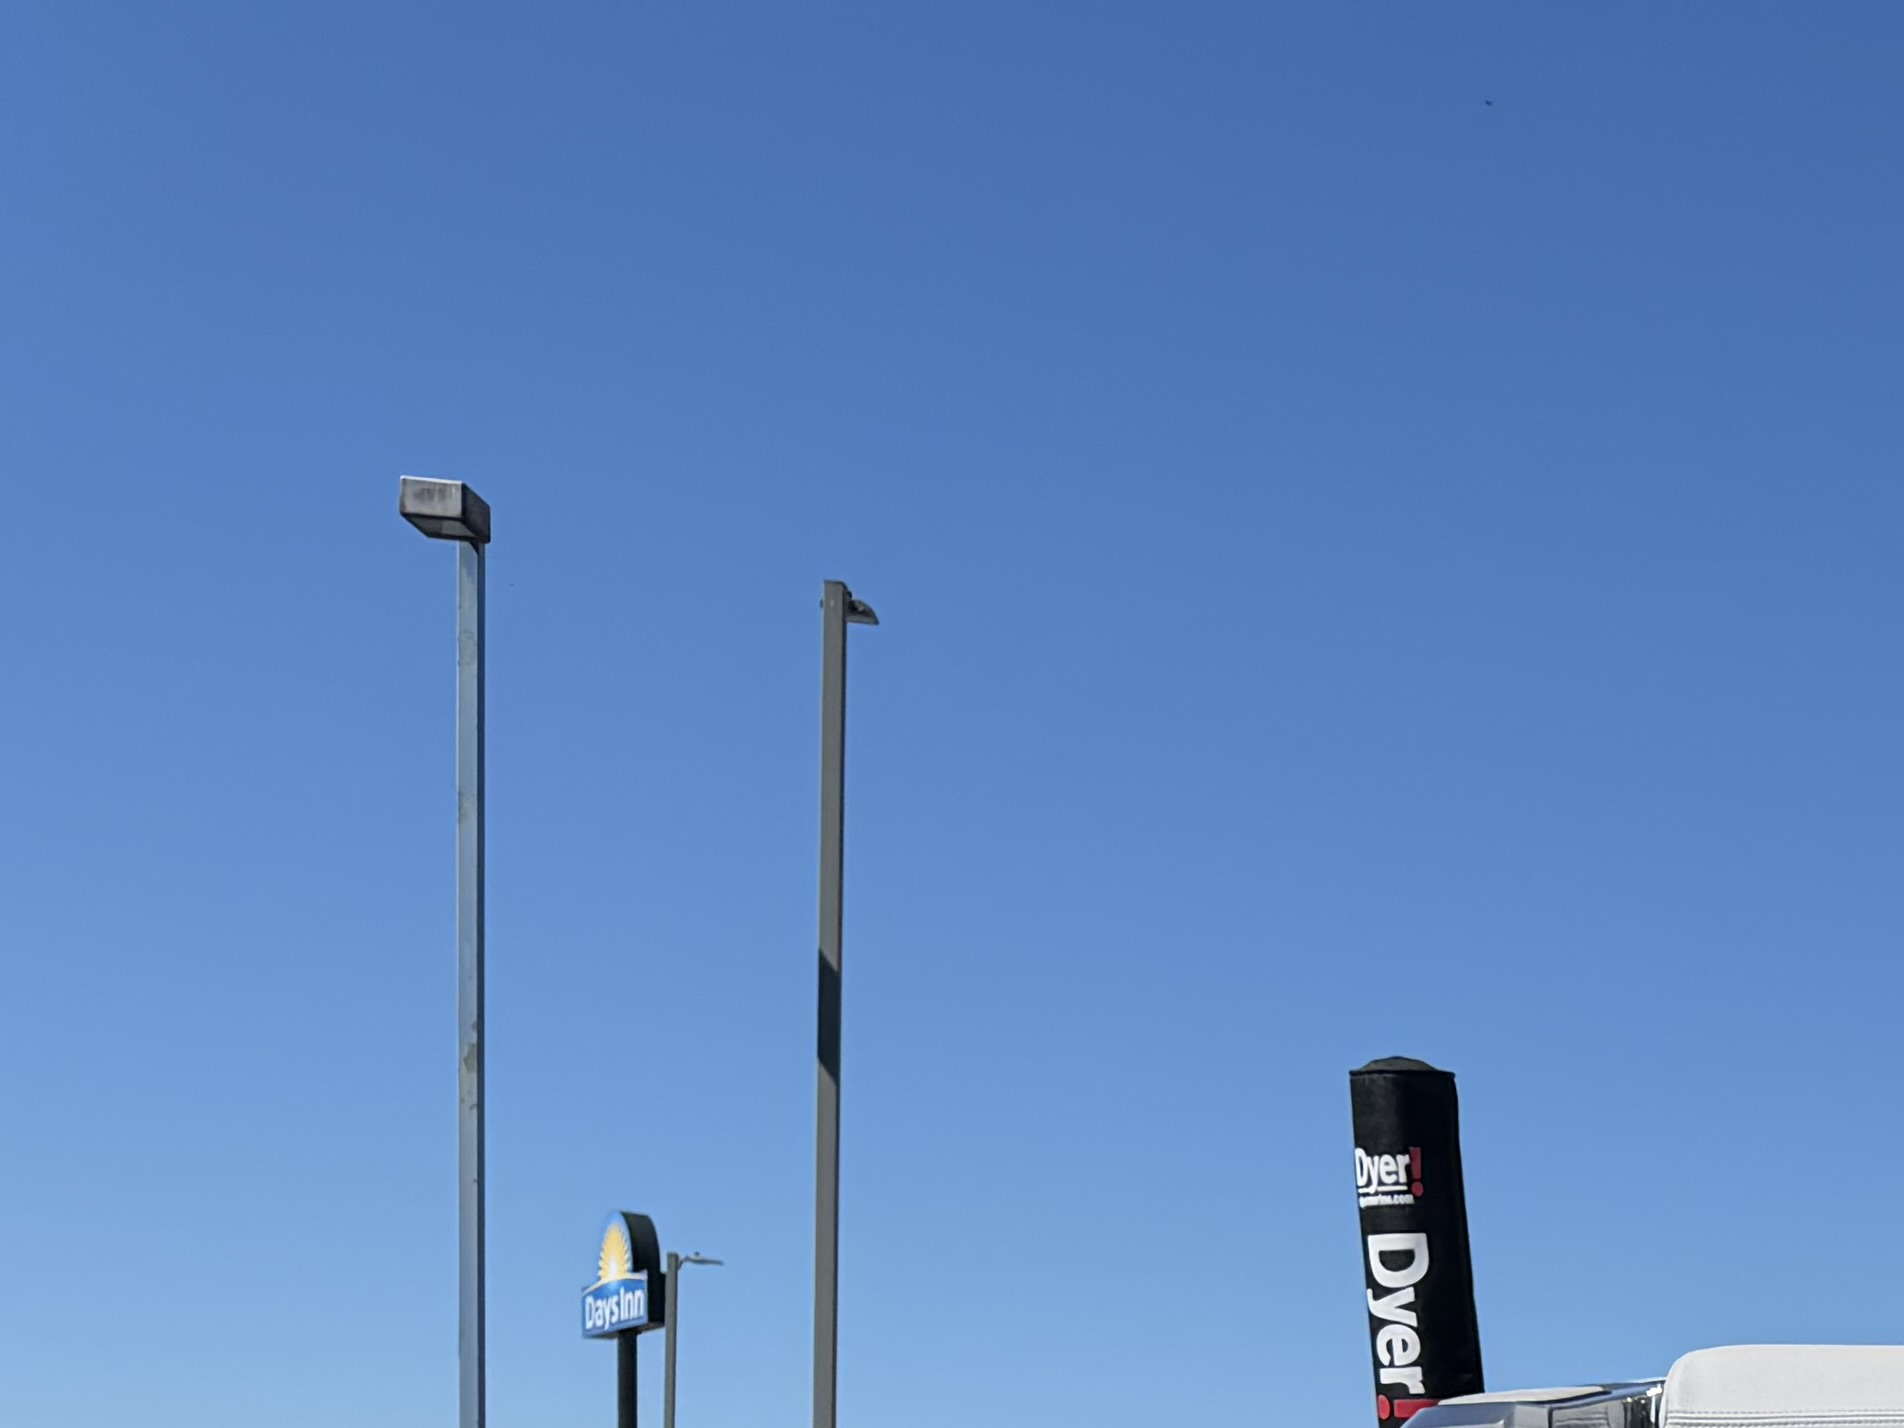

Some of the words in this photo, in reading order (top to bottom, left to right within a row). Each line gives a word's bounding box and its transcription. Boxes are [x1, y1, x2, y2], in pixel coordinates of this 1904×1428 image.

[1355, 1146, 1424, 1198] Dyer!
[585, 1294, 619, 1331] Days
[619, 1286, 645, 1321] Inn
